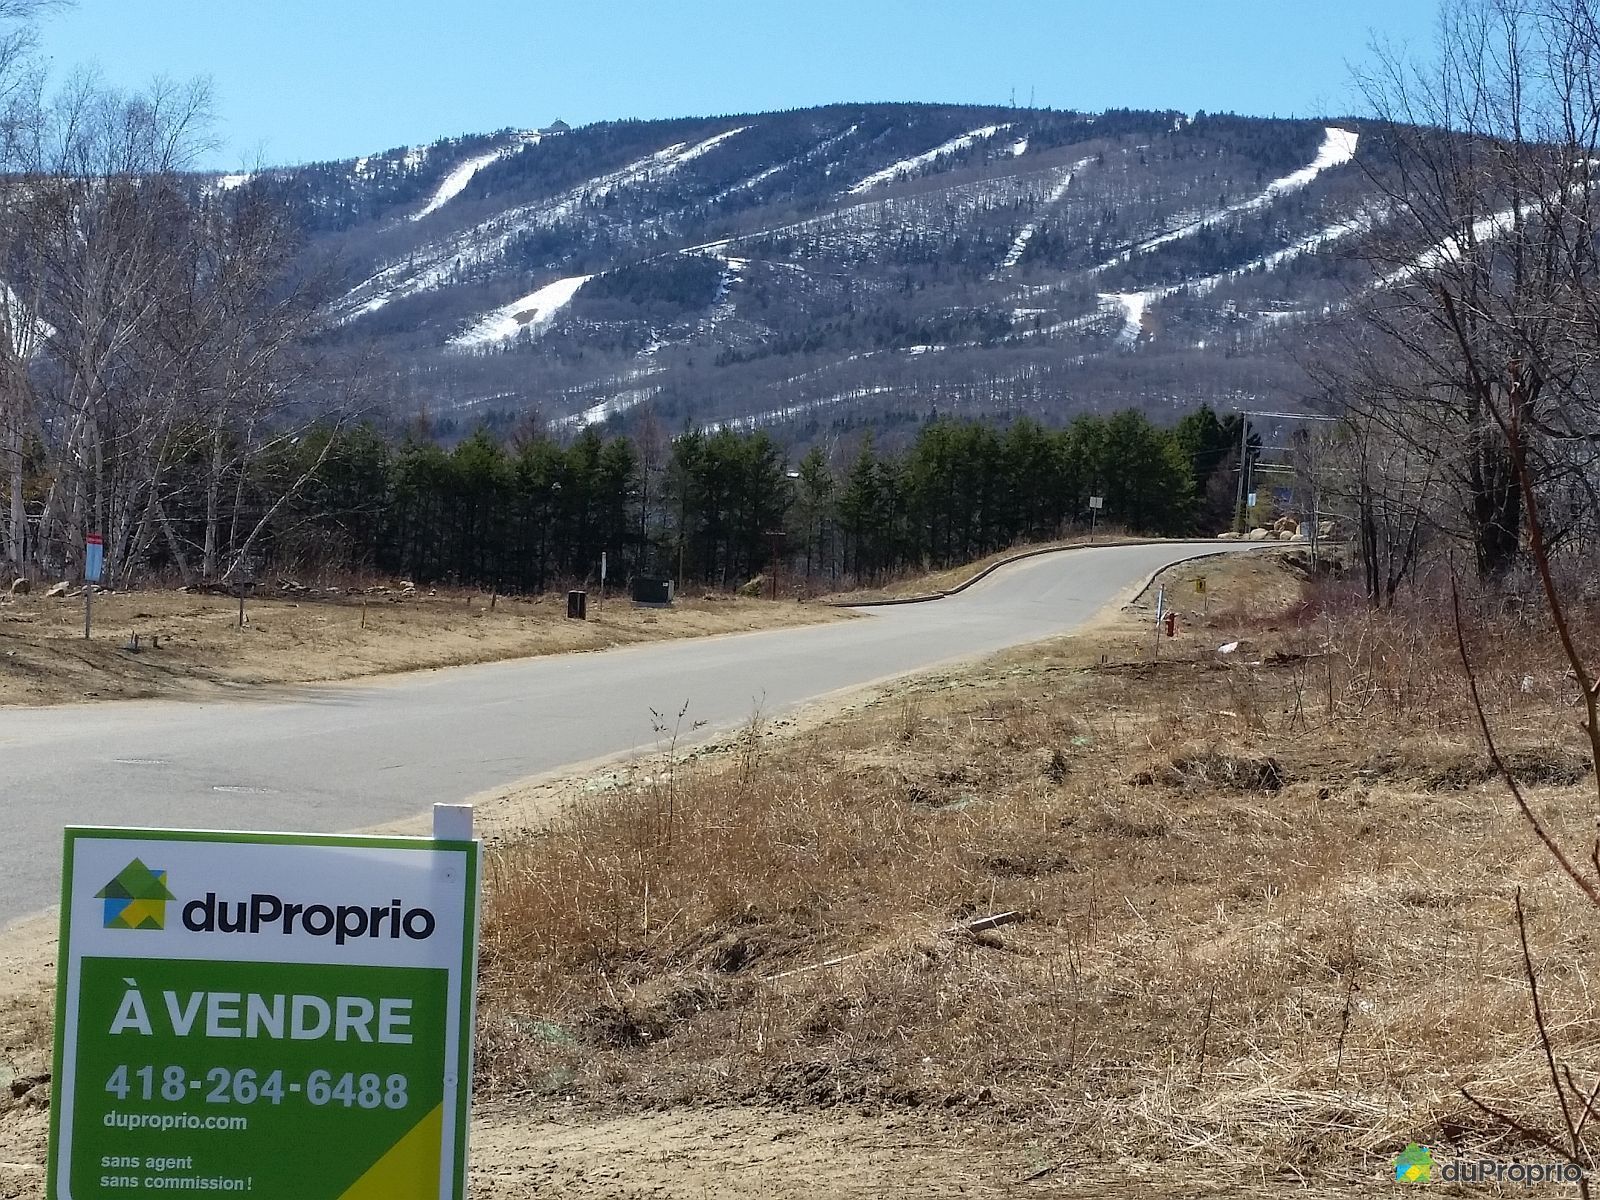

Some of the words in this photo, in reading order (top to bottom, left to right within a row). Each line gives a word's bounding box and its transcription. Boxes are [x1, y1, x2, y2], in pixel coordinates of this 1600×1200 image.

[182, 892, 436, 945] duProprio
[108, 977, 153, 1037] À
[163, 991, 413, 1044] VENDRE
[104, 1065, 408, 1109] 418-264-6488
[103, 1111, 247, 1131] duproprio.com
[101, 1155, 140, 1168] sans
[145, 1154, 193, 1174] agent
[100, 1174, 140, 1188] sans
